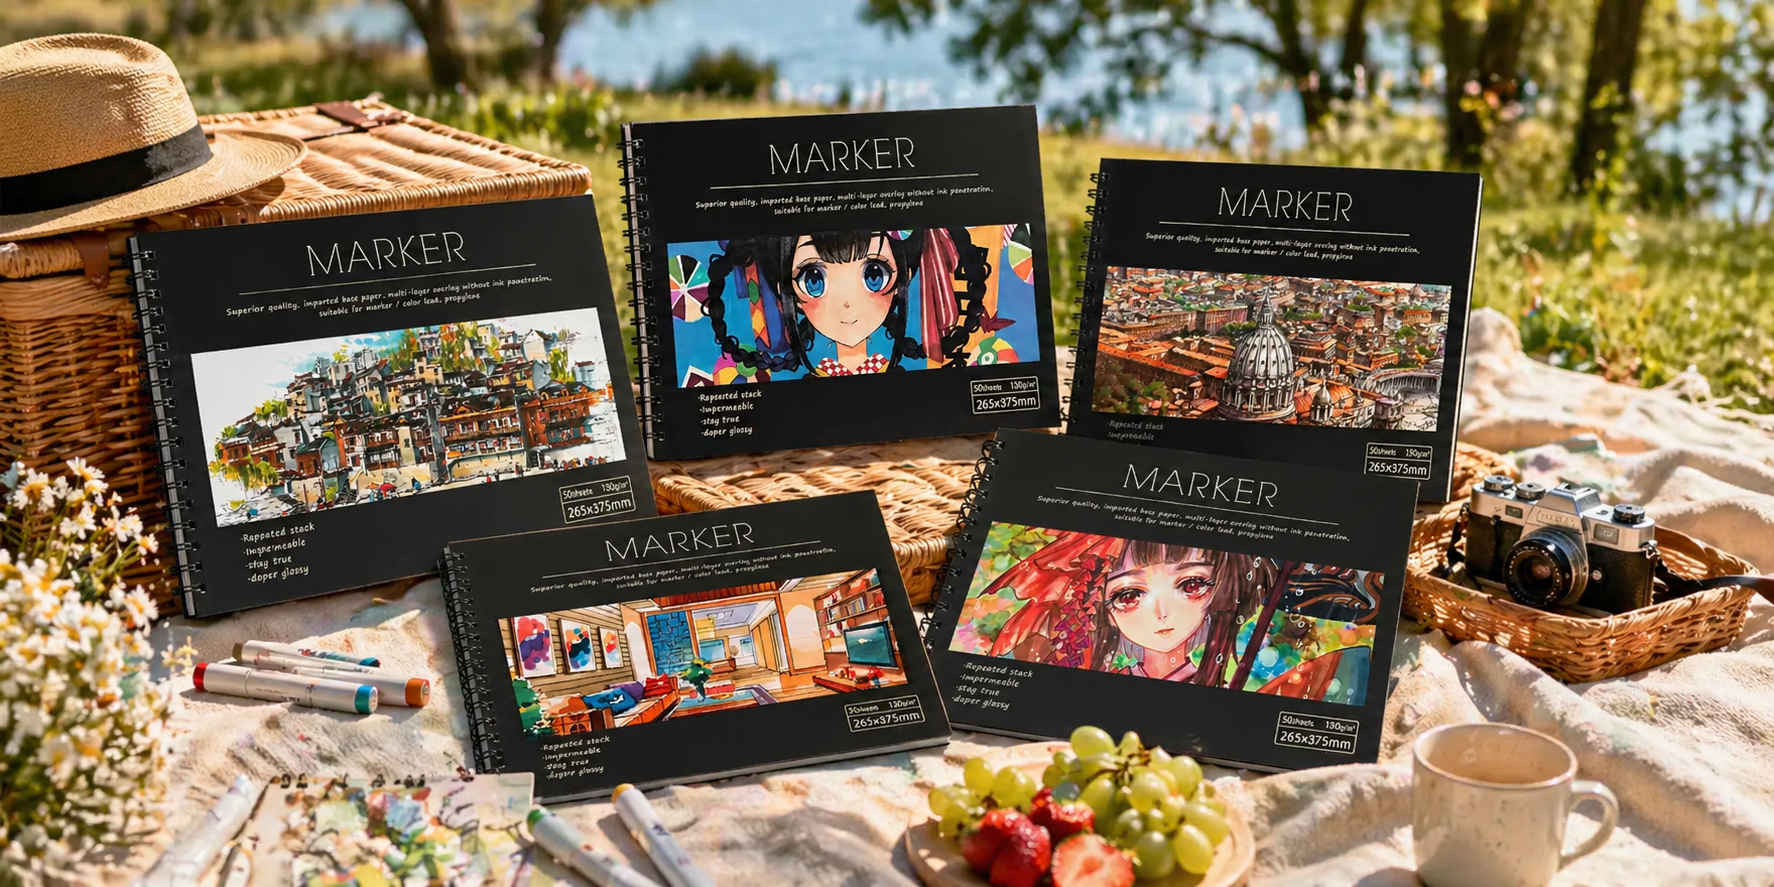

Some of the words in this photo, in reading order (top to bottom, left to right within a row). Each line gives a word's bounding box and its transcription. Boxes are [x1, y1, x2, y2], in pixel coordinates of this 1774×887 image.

[769, 137, 915, 175] MARKER
[1218, 187, 1353, 221] MARKER
[306, 231, 466, 276] MARKER
[226, 305, 264, 317] Superior
[492, 279, 504, 287] ink
[351, 305, 362, 313] for
[976, 396, 1036, 410] 265x375mm
[1368, 461, 1427, 475] 265x375mm
[1123, 464, 1278, 508] MARKER
[567, 499, 631, 518] 265x375mm
[290, 522, 315, 534] stack
[604, 522, 754, 562] MARKER
[1009, 669, 1033, 678] stack
[853, 712, 920, 728] 265x375mm
[1280, 730, 1351, 750] 265x375mm
